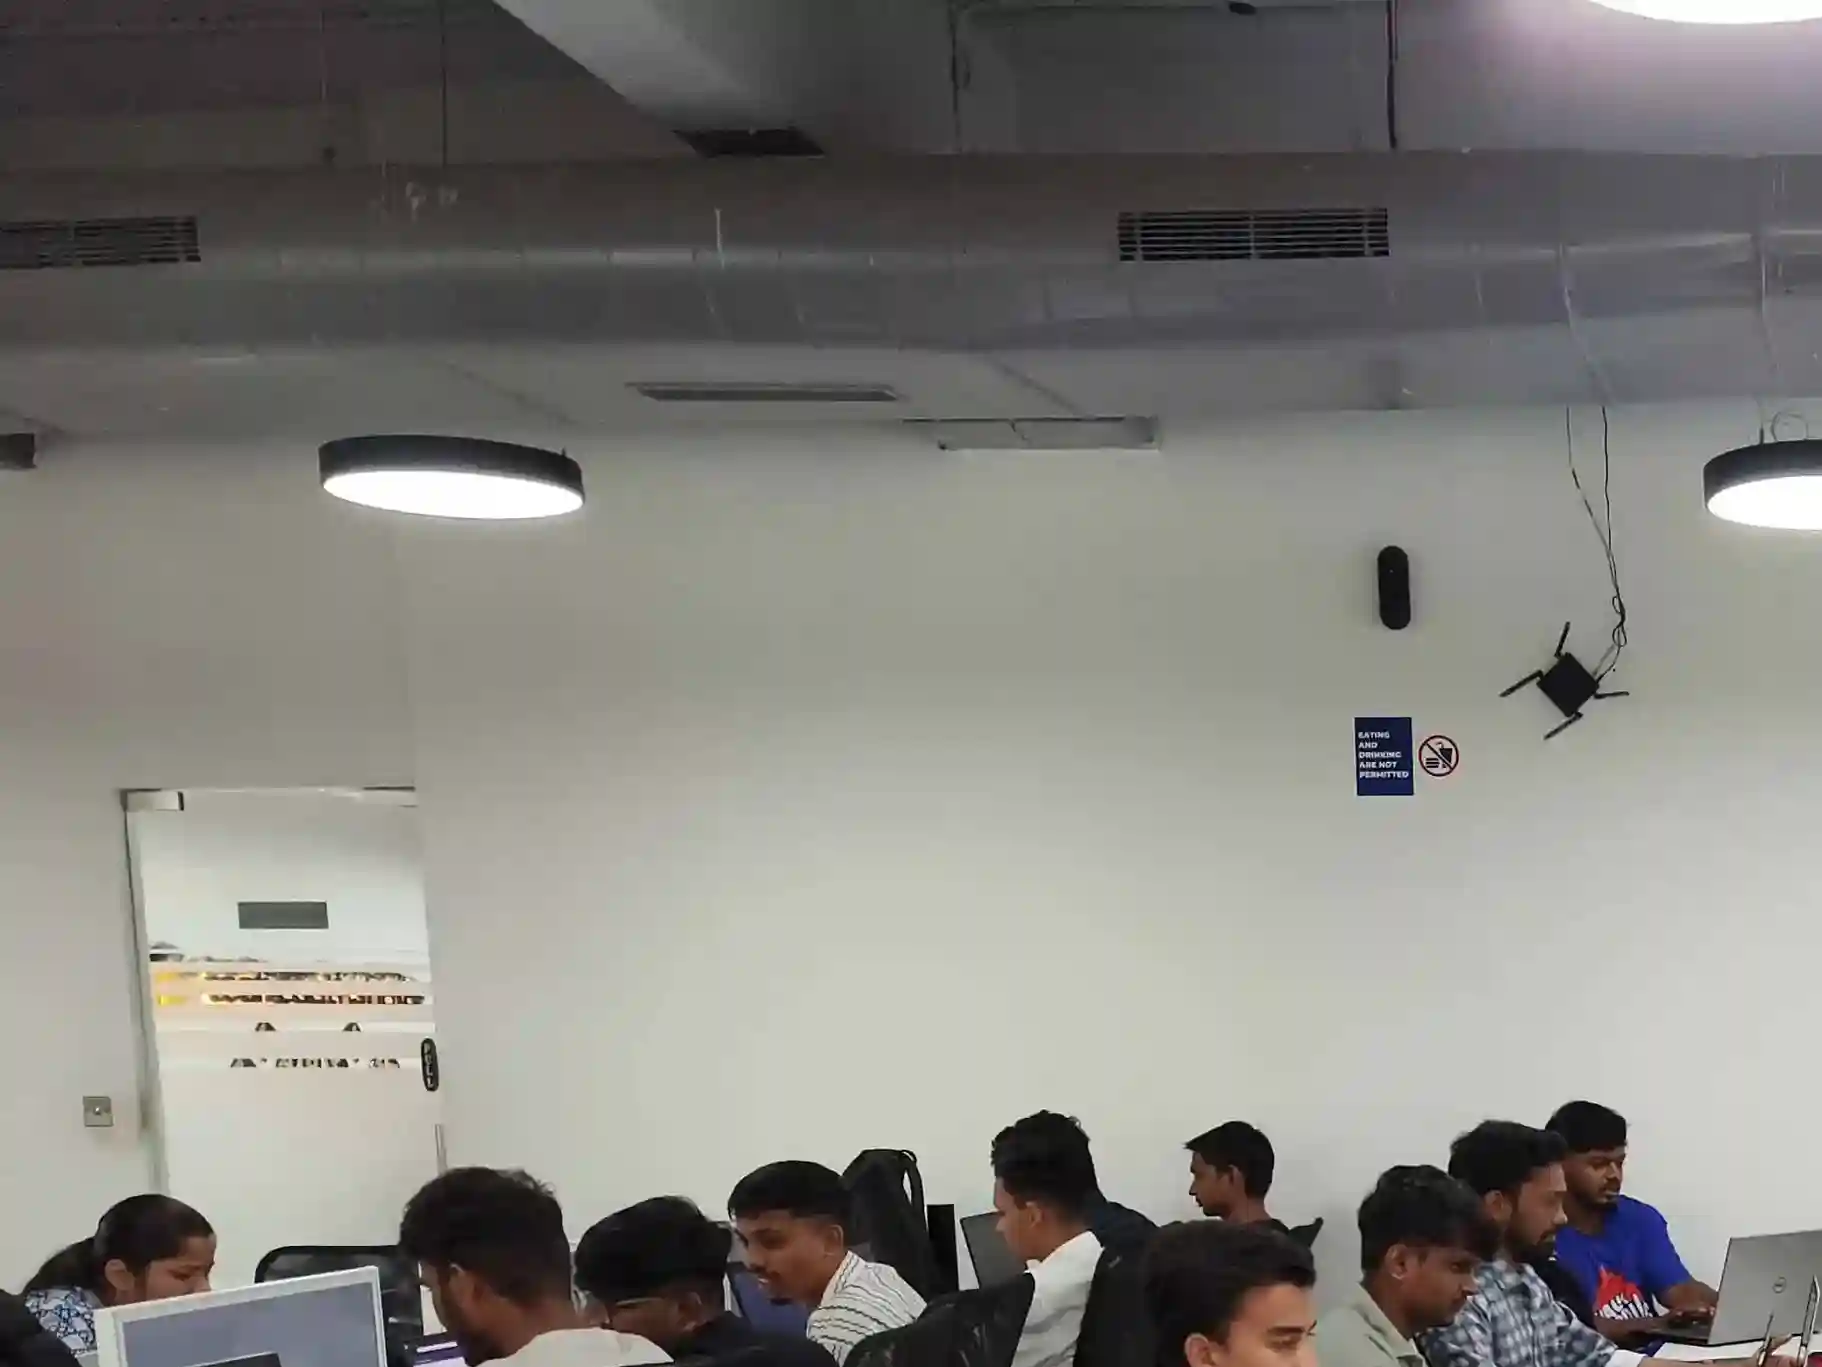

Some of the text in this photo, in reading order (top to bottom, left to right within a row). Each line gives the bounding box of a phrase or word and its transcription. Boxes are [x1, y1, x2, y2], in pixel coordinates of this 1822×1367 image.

[1358, 731, 1390, 739] EATING
[1359, 751, 1402, 759] DRINKING
[1360, 761, 1398, 769] ARE NOT
[1359, 771, 1410, 779] PERMITTED
